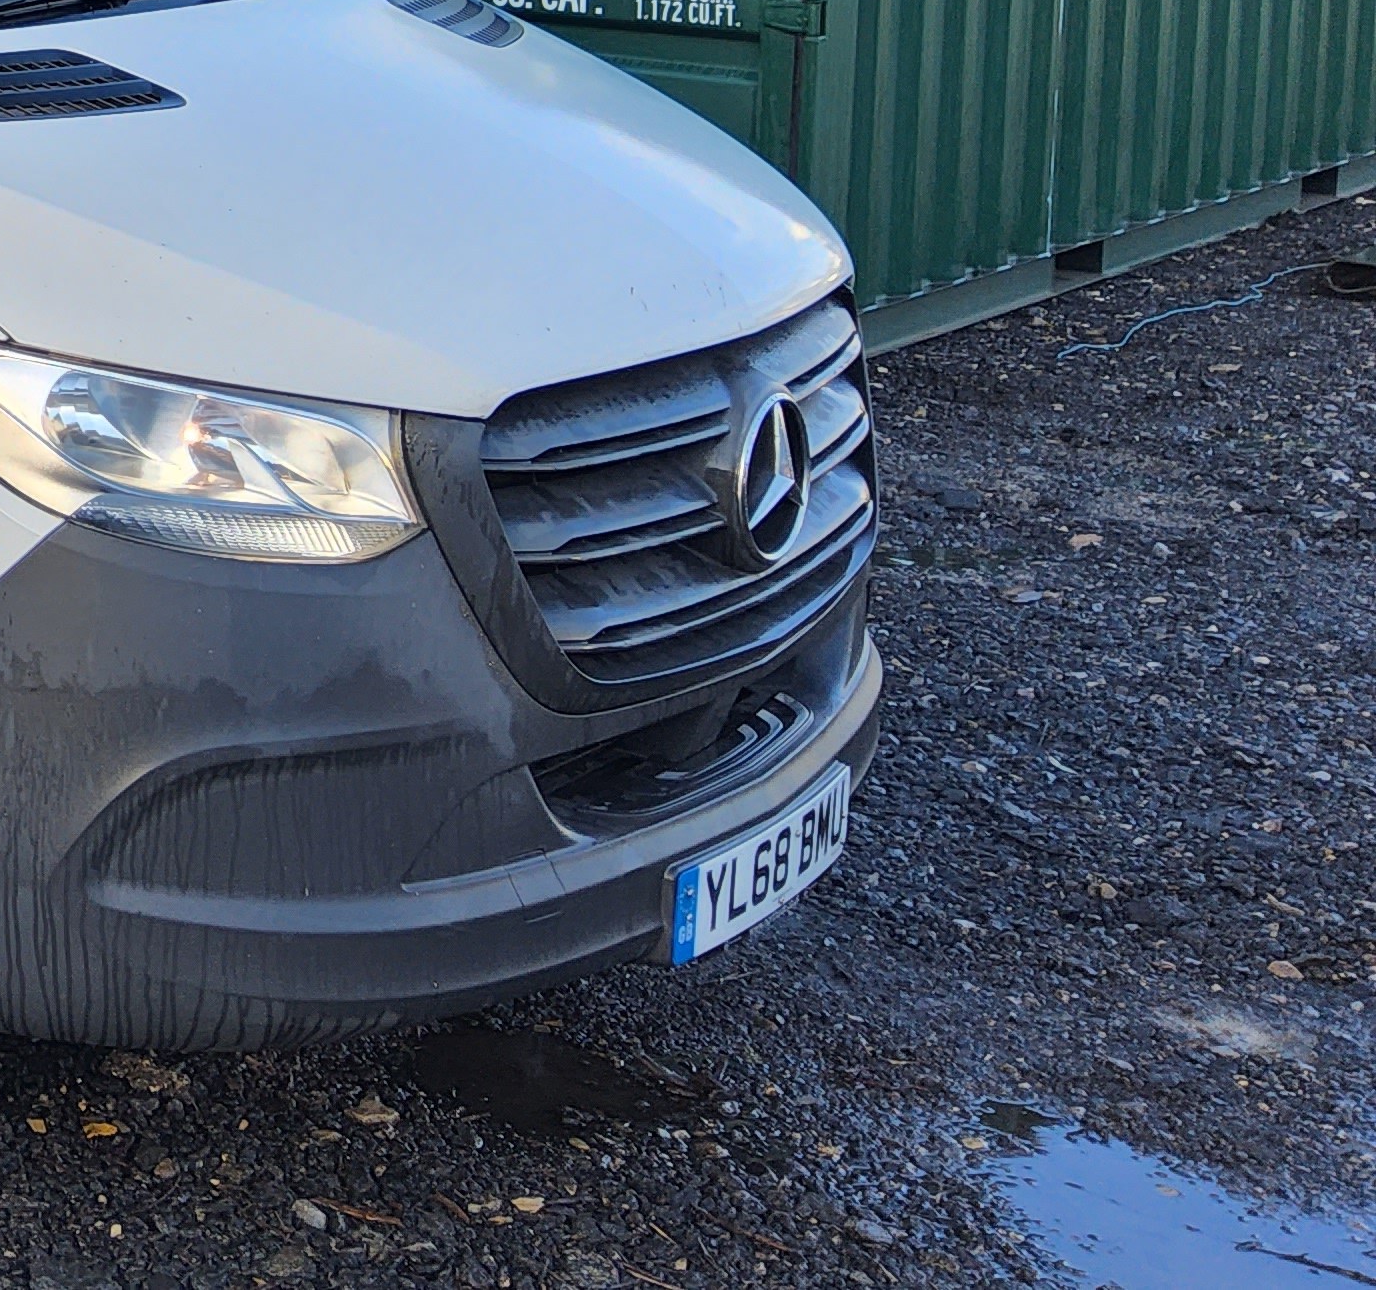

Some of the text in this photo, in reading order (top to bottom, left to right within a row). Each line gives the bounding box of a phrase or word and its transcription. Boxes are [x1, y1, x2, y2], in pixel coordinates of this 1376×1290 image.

[688, 2, 741, 27] CU.FT.
[706, 779, 845, 932] YL 68 BMU
[678, 922, 693, 944] GB
